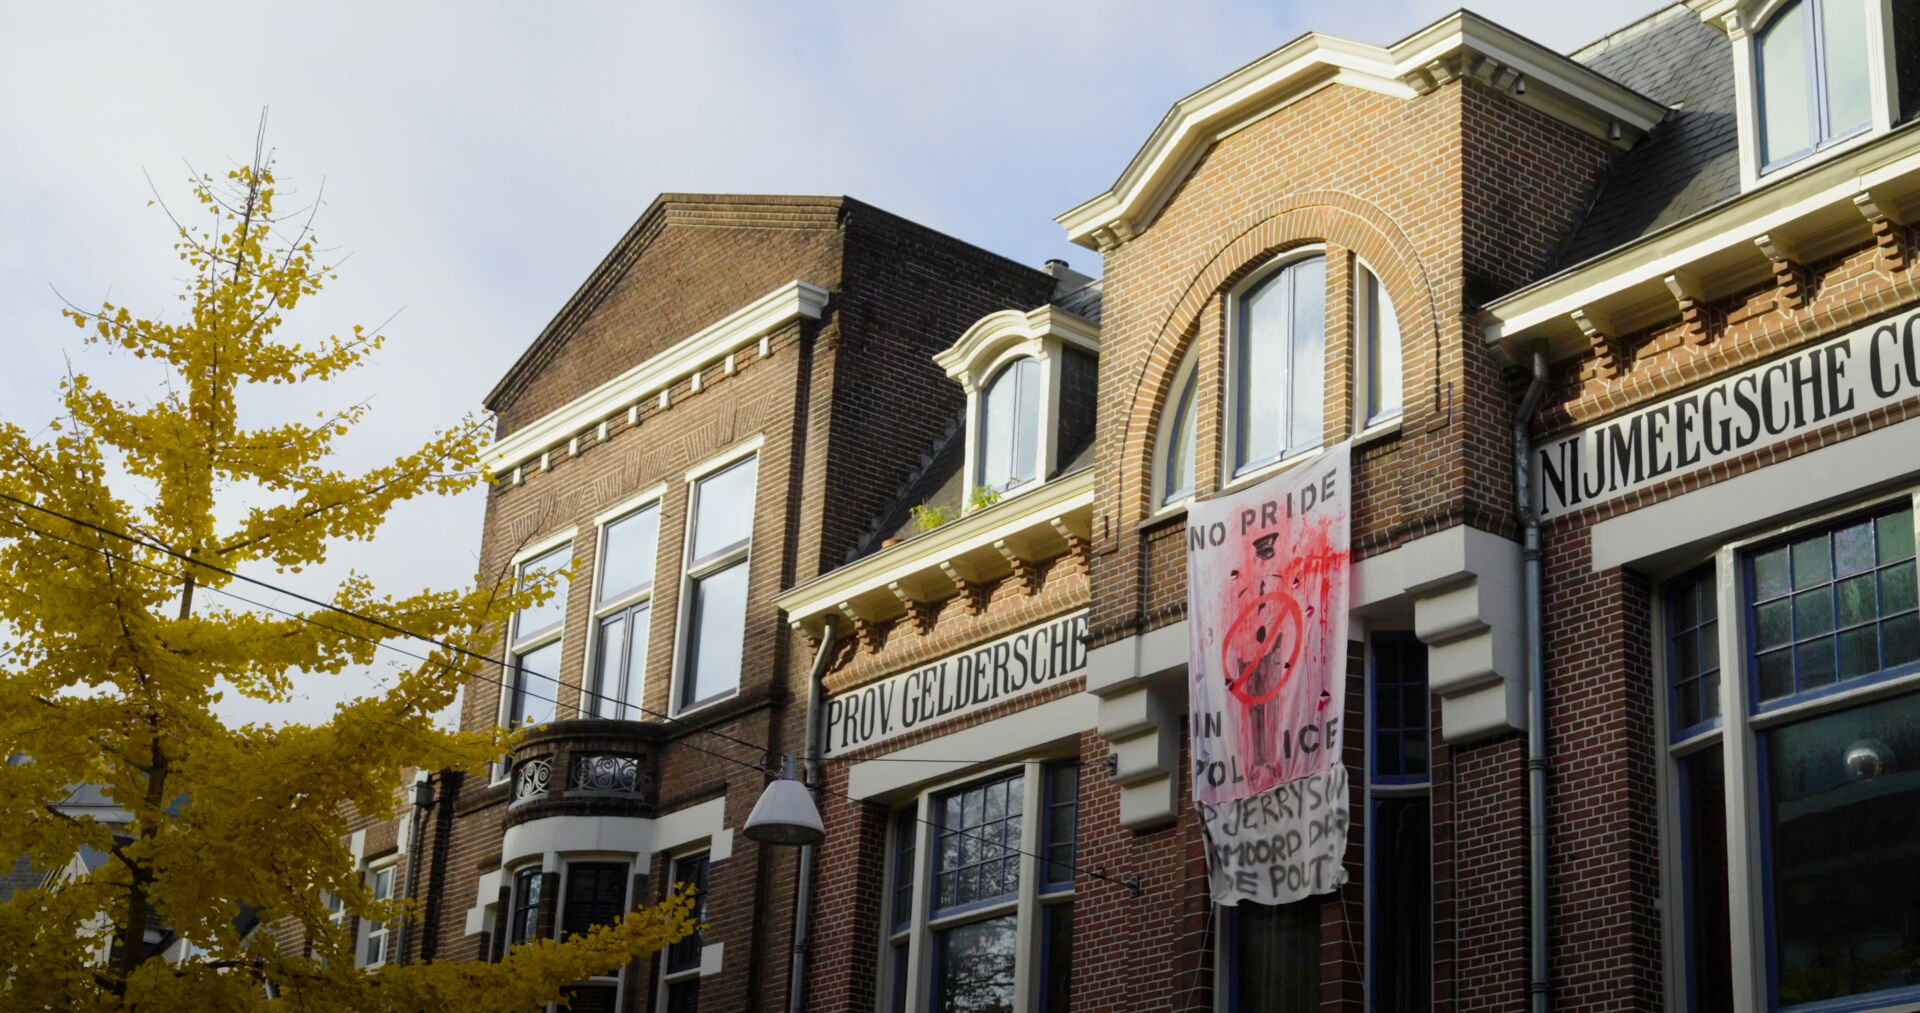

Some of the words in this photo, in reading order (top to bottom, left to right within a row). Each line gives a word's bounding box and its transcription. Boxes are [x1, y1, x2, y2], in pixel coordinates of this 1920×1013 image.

[1539, 338, 1855, 515] NIJMEEGSCHE
[1190, 521, 1226, 551] NO
[1241, 467, 1337, 536] PRIDE
[824, 679, 895, 754] PROV.
[901, 613, 1090, 728] GELDERSCHE
[1194, 711, 1222, 739] IN
